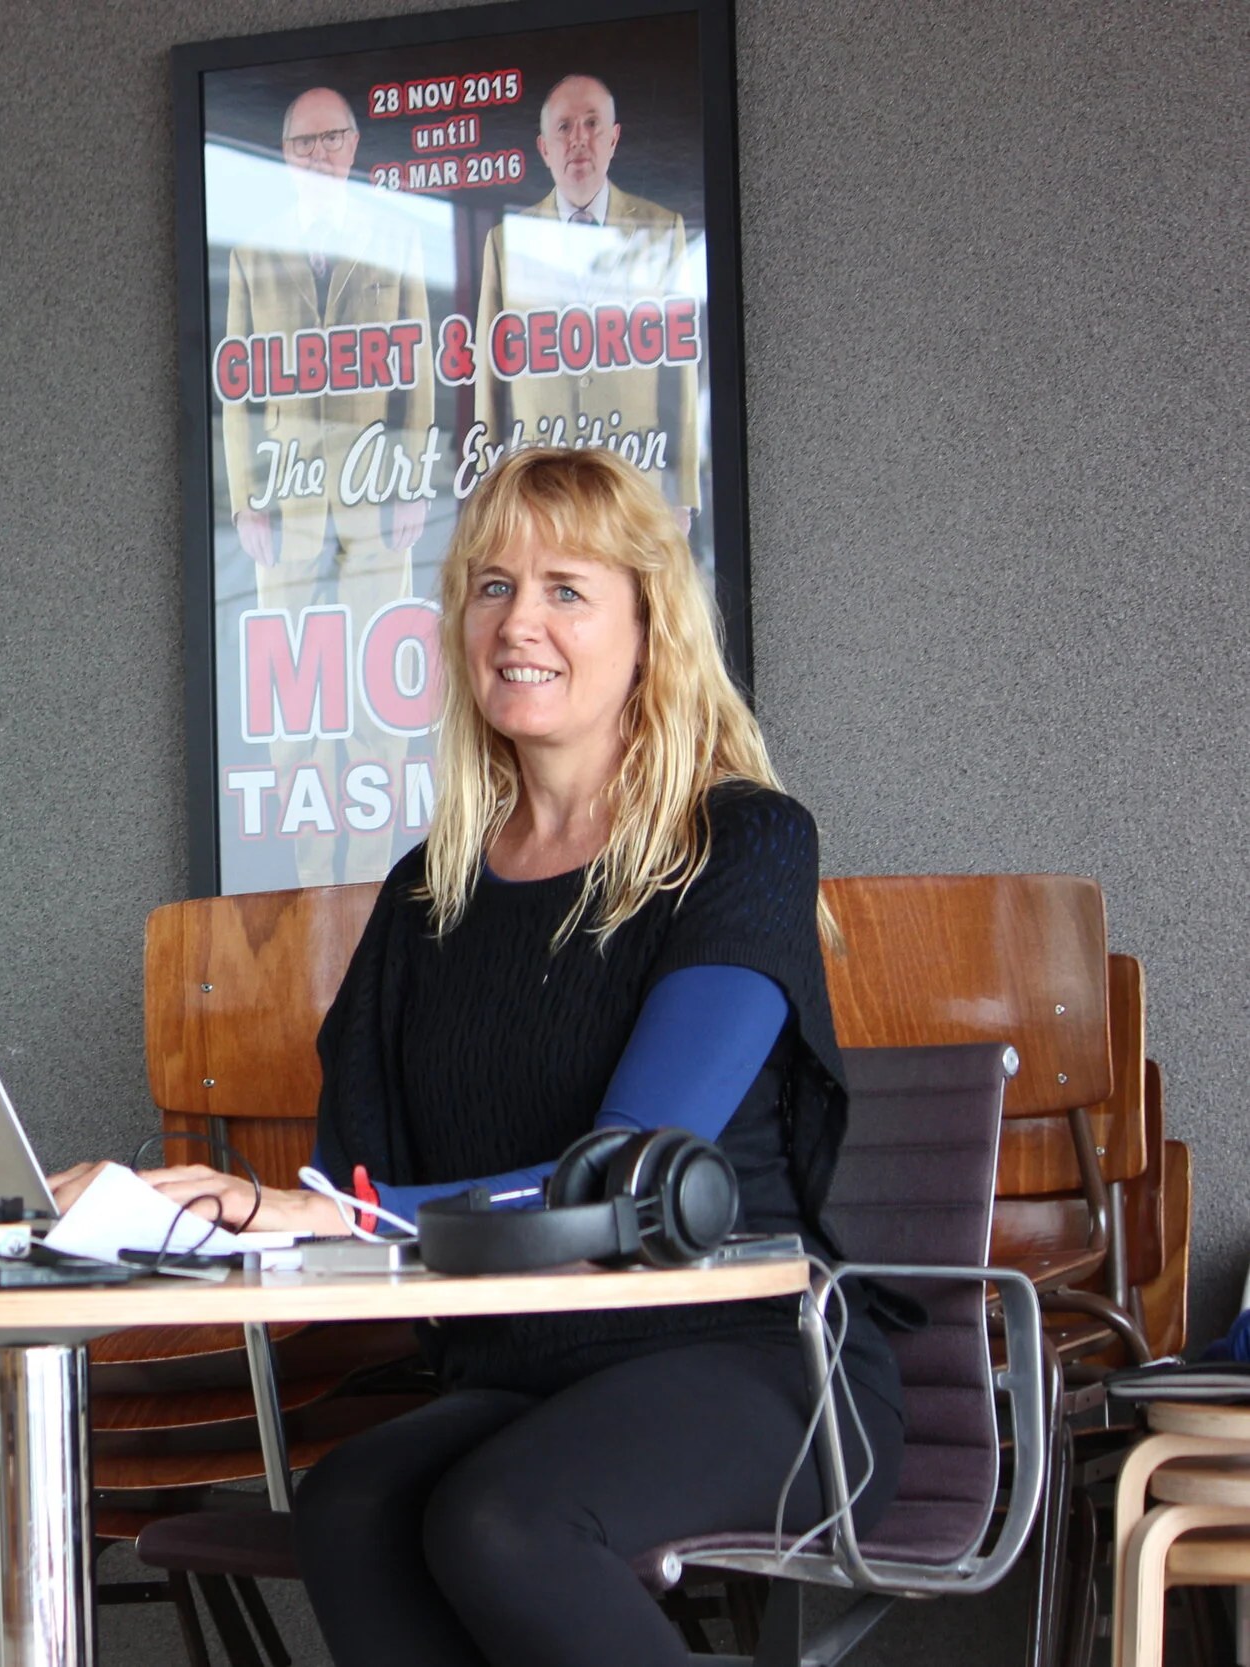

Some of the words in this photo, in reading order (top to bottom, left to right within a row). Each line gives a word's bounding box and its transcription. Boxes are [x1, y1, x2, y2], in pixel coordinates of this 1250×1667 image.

[371, 85, 401, 115] 28
[406, 80, 456, 111] NOV
[462, 72, 519, 104] 2015
[415, 117, 477, 149] until
[373, 165, 401, 193] 28
[407, 160, 460, 190] MAR
[466, 152, 522, 184] 2016
[214, 321, 424, 401] GILBERT
[437, 314, 476, 385] &
[491, 298, 701, 381] GEORGE
[249, 439, 325, 510] The
[340, 420, 442, 506] Art
[240, 598, 444, 743] MO
[226, 760, 436, 840] TASM
